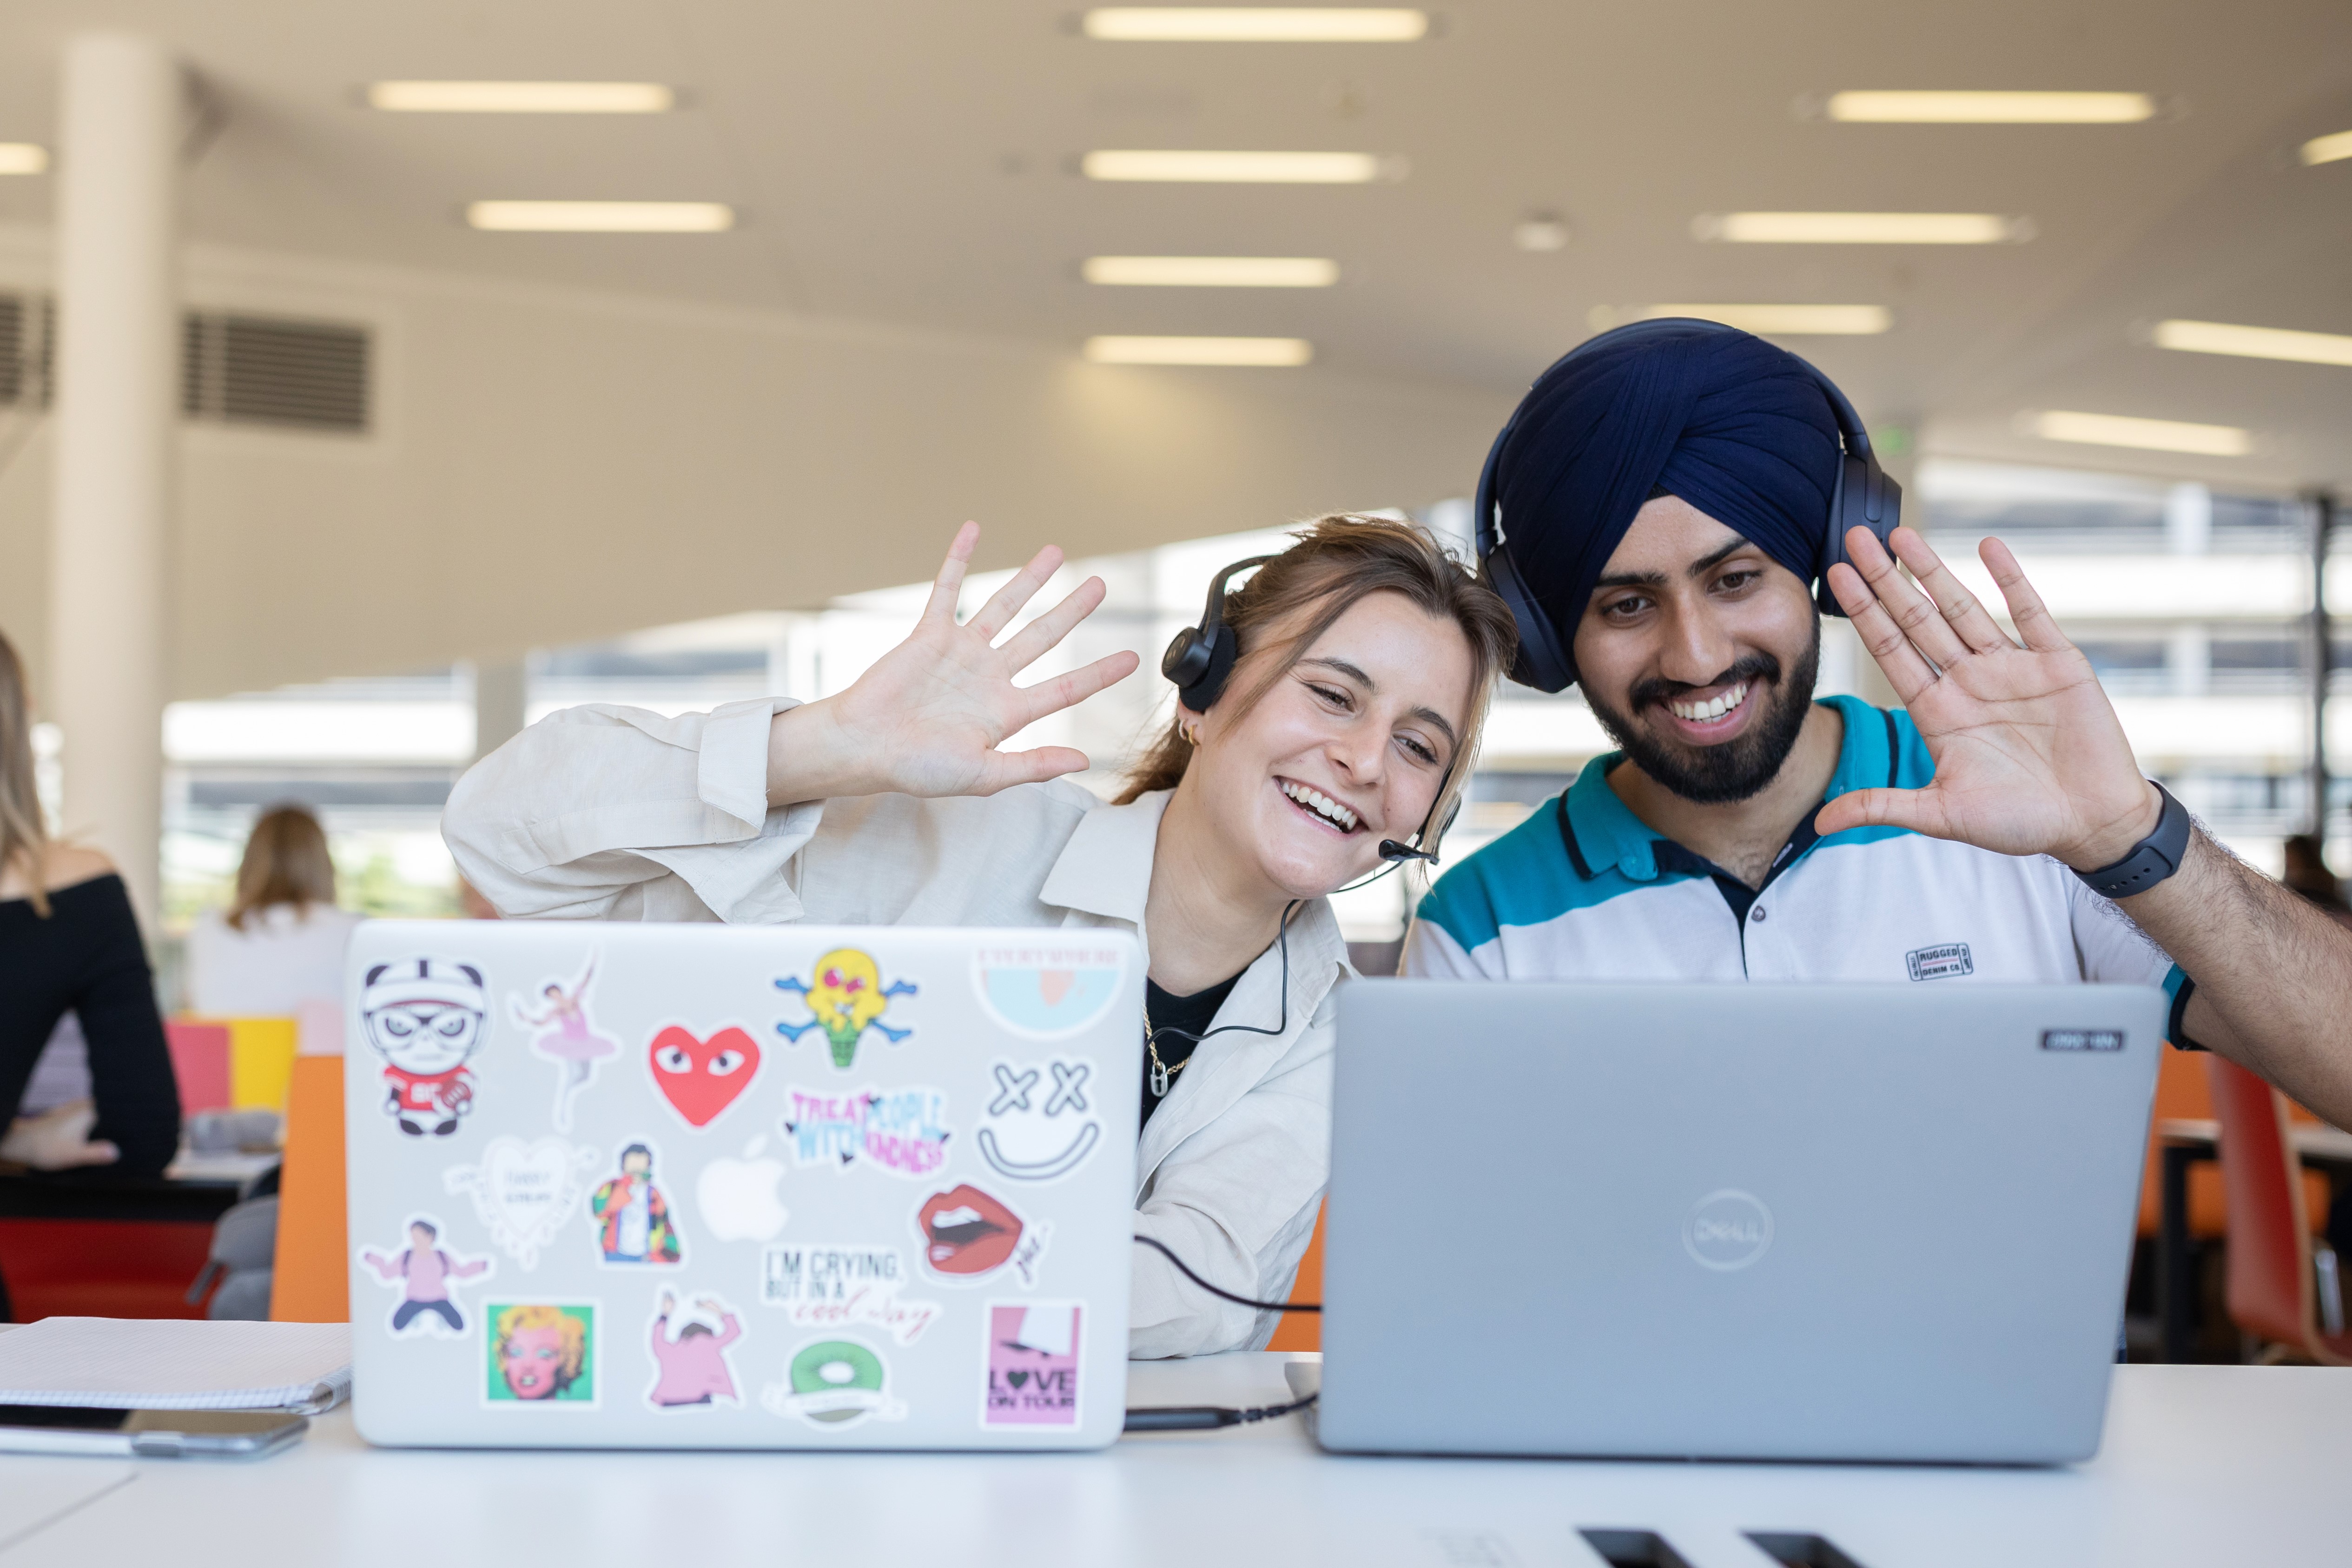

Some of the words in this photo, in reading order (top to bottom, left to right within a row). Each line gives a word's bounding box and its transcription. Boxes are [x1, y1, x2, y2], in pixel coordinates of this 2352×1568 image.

[1920, 948, 1957, 961] RUGGED
[1923, 966, 1947, 975] DENIM
[792, 1092, 869, 1122] TREAT
[766, 1281, 800, 1298] BUT
[808, 1281, 826, 1298] IN
[834, 1282, 844, 1298] A
[989, 1396, 1015, 1407] ON
[1024, 1396, 1075, 1409] TOUR
